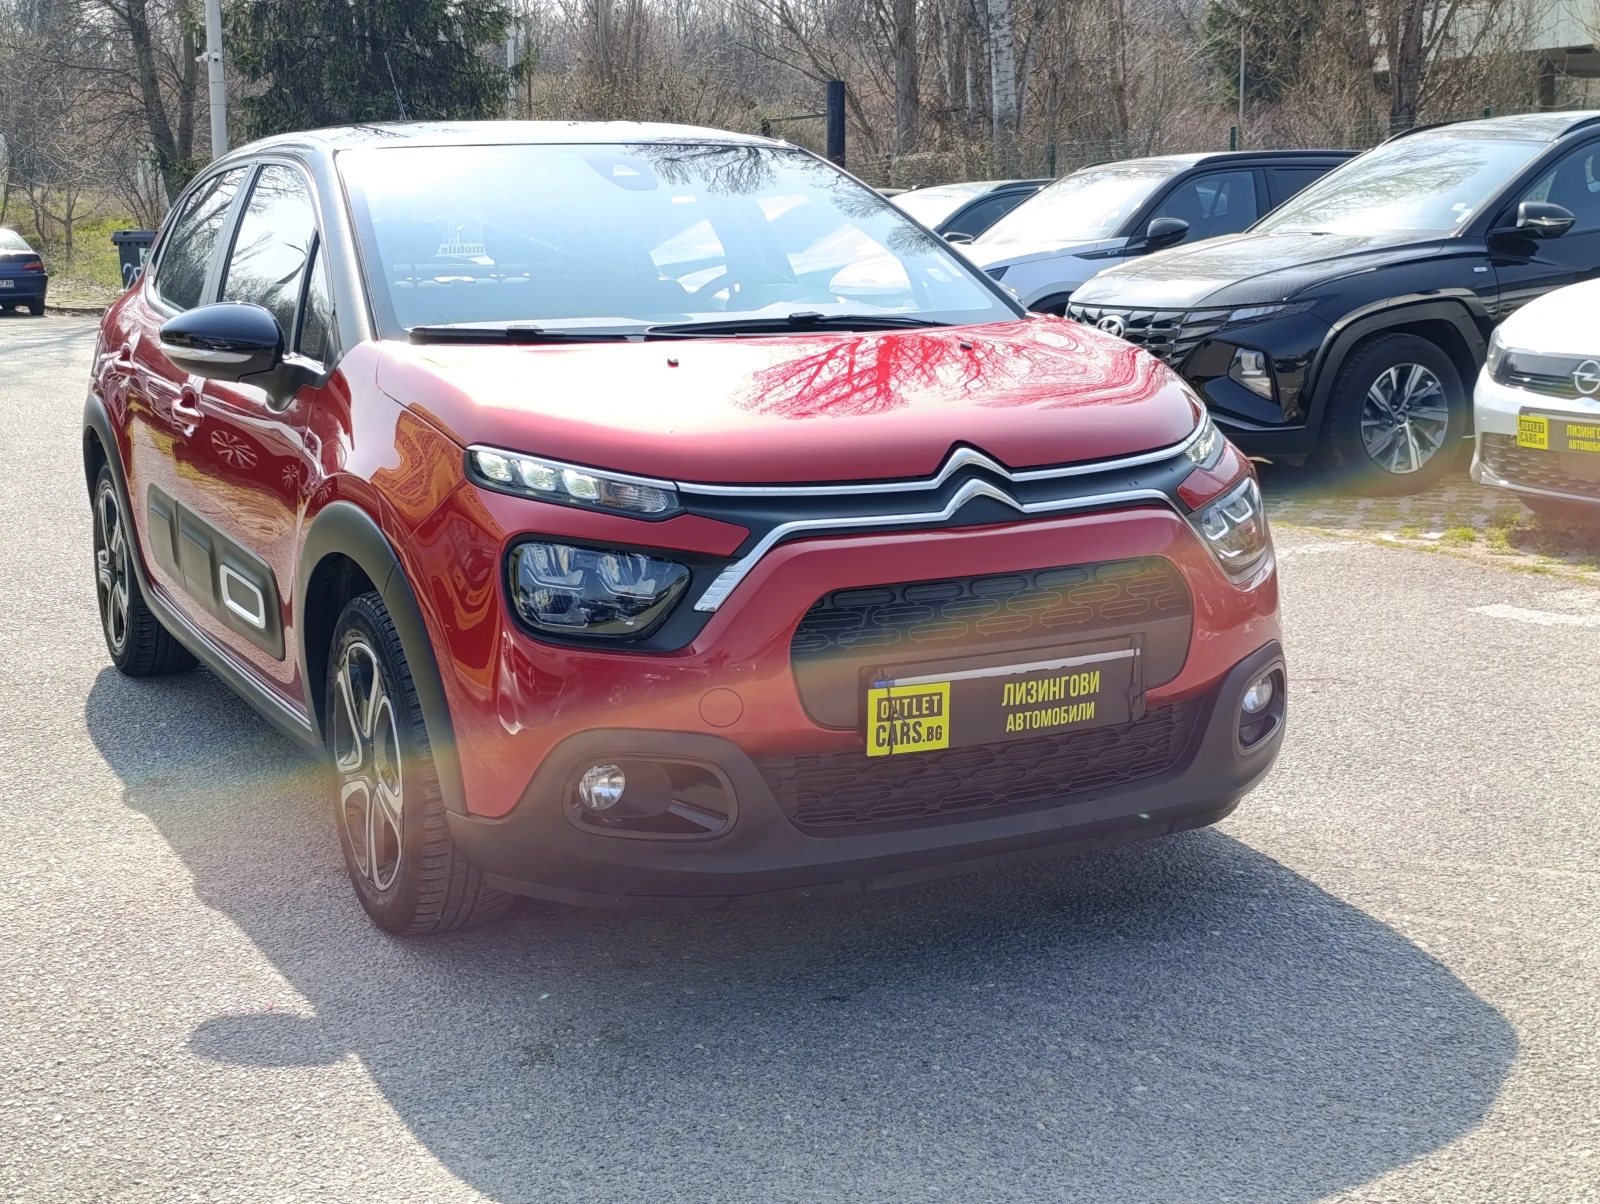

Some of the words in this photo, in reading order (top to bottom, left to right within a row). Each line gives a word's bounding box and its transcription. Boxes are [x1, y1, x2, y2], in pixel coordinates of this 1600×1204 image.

[1520, 421, 1544, 433] OUTLET
[1001, 670, 1100, 707] ЛИЗИНГОВИ
[880, 695, 940, 719] OUTLET
[1005, 701, 1095, 733] АВТОМОБИЛИ
[875, 720, 943, 747] CARS.BG
